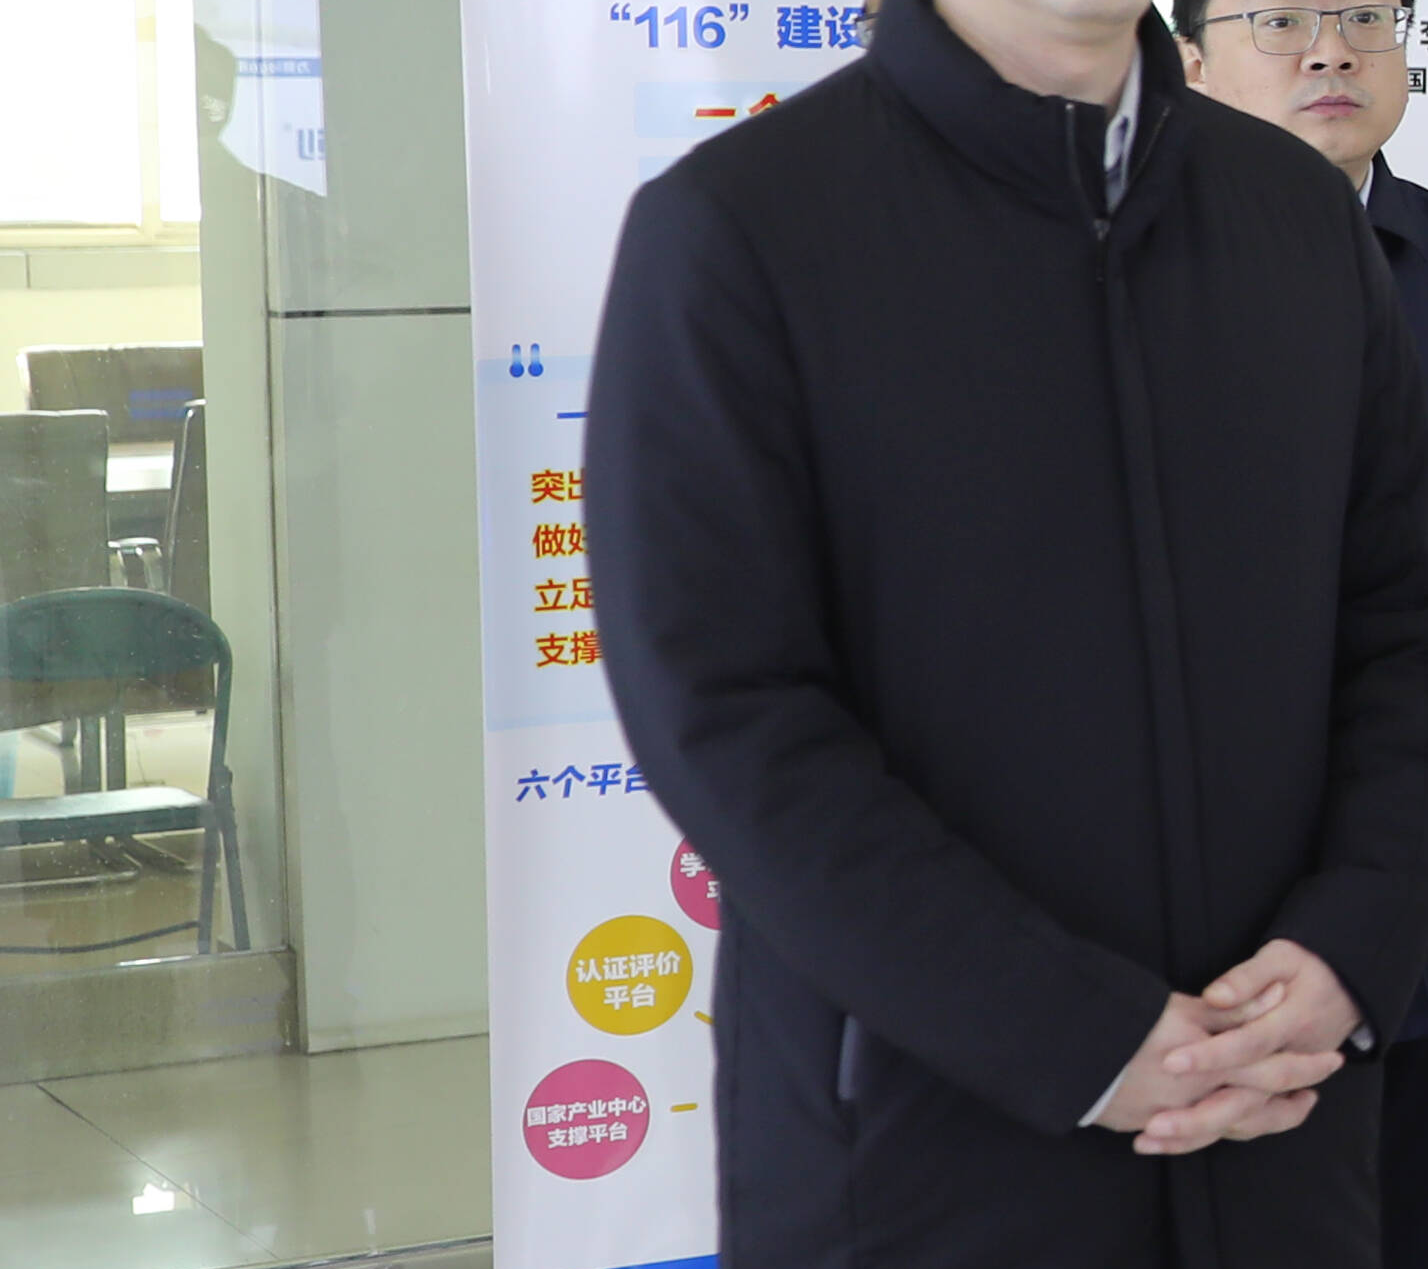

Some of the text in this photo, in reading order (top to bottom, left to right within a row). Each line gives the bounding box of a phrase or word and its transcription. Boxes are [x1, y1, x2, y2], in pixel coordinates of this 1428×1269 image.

[516, 762, 651, 802] 六个平台
[575, 951, 682, 984] 认证评价
[603, 983, 657, 1011] 平台
[526, 1096, 647, 1127] 国家产业中心
[547, 1122, 629, 1149] 支撑平台
